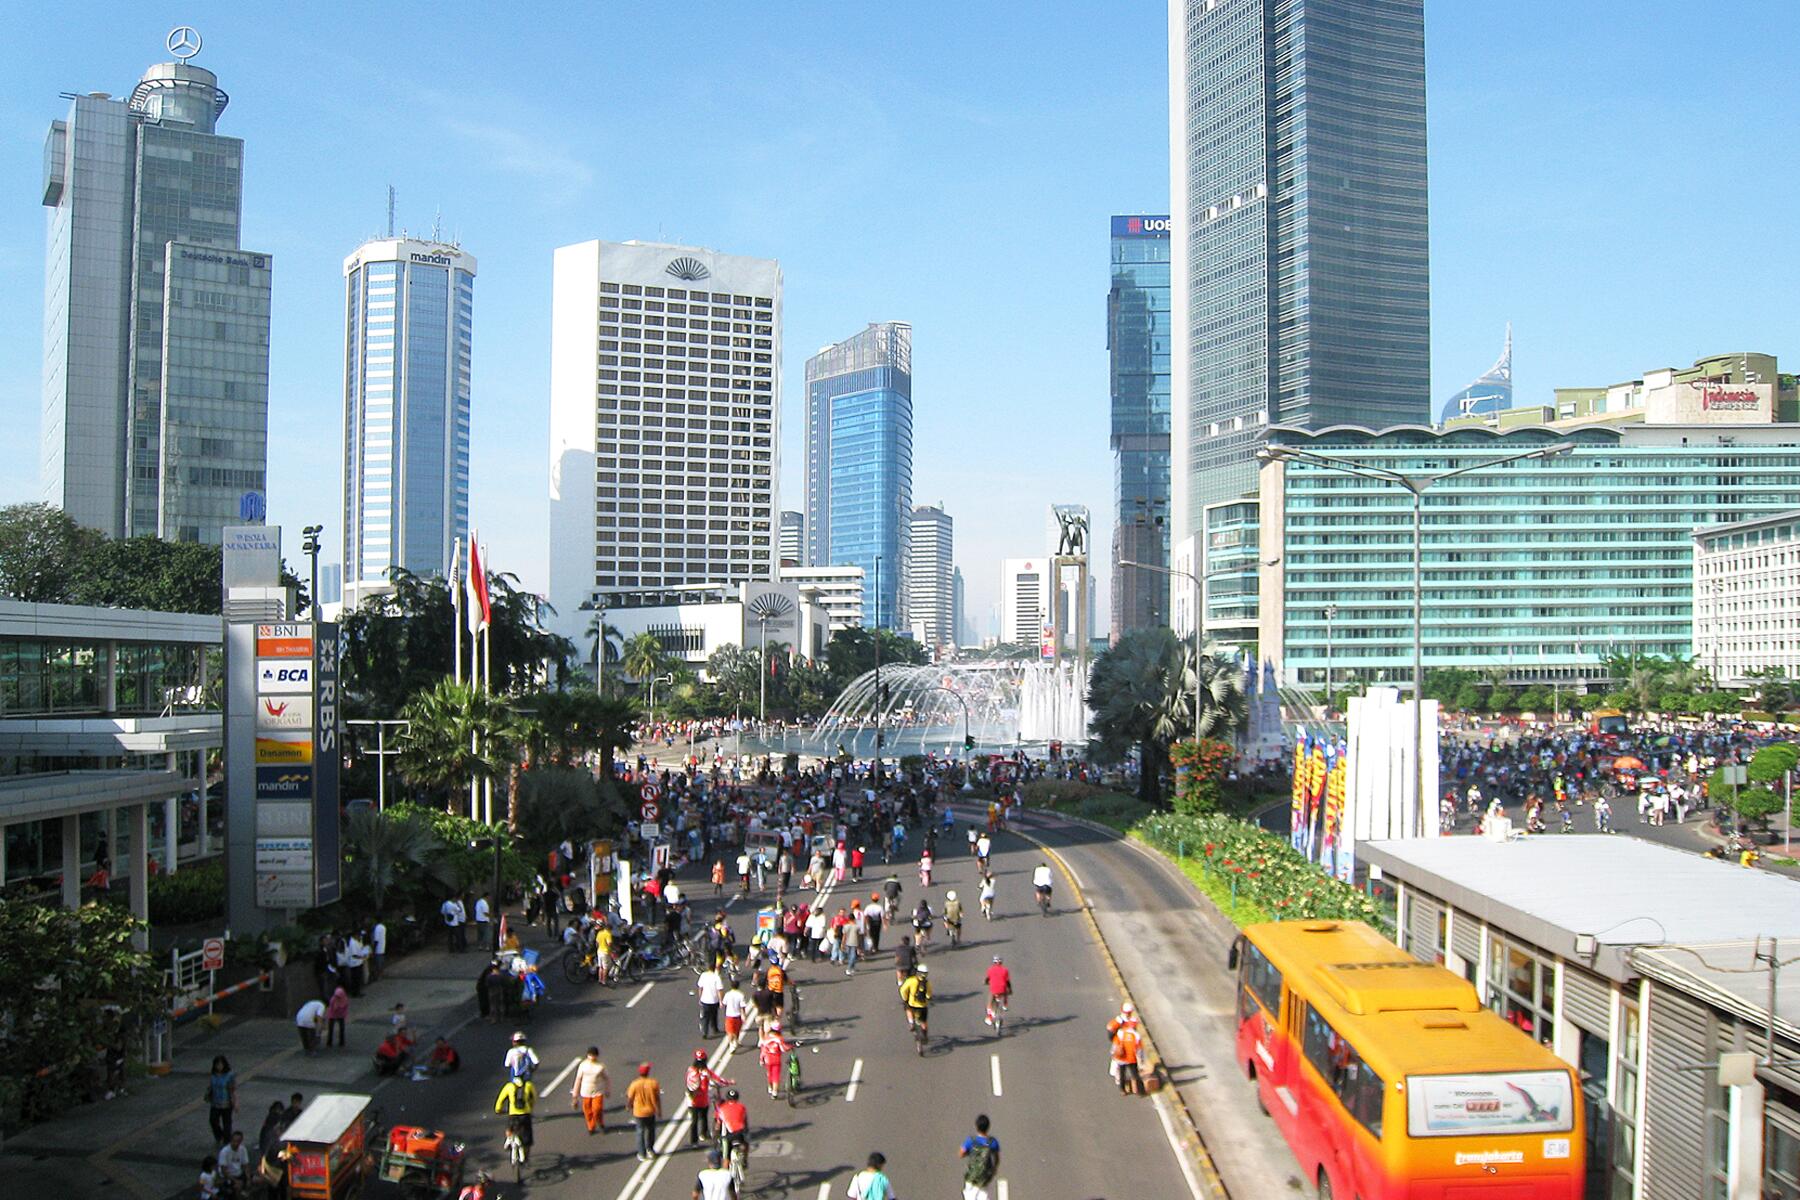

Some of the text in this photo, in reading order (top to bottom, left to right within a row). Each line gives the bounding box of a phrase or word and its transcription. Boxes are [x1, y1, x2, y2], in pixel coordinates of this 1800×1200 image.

[181, 250, 249, 266] Deutsche Bank
[410, 252, 451, 265] mandiri
[274, 625, 298, 637] BNI
[277, 669, 308, 681] BCA
[320, 680, 336, 753] RBS
[260, 748, 302, 758] Danamon
[258, 780, 299, 791] mandiri
